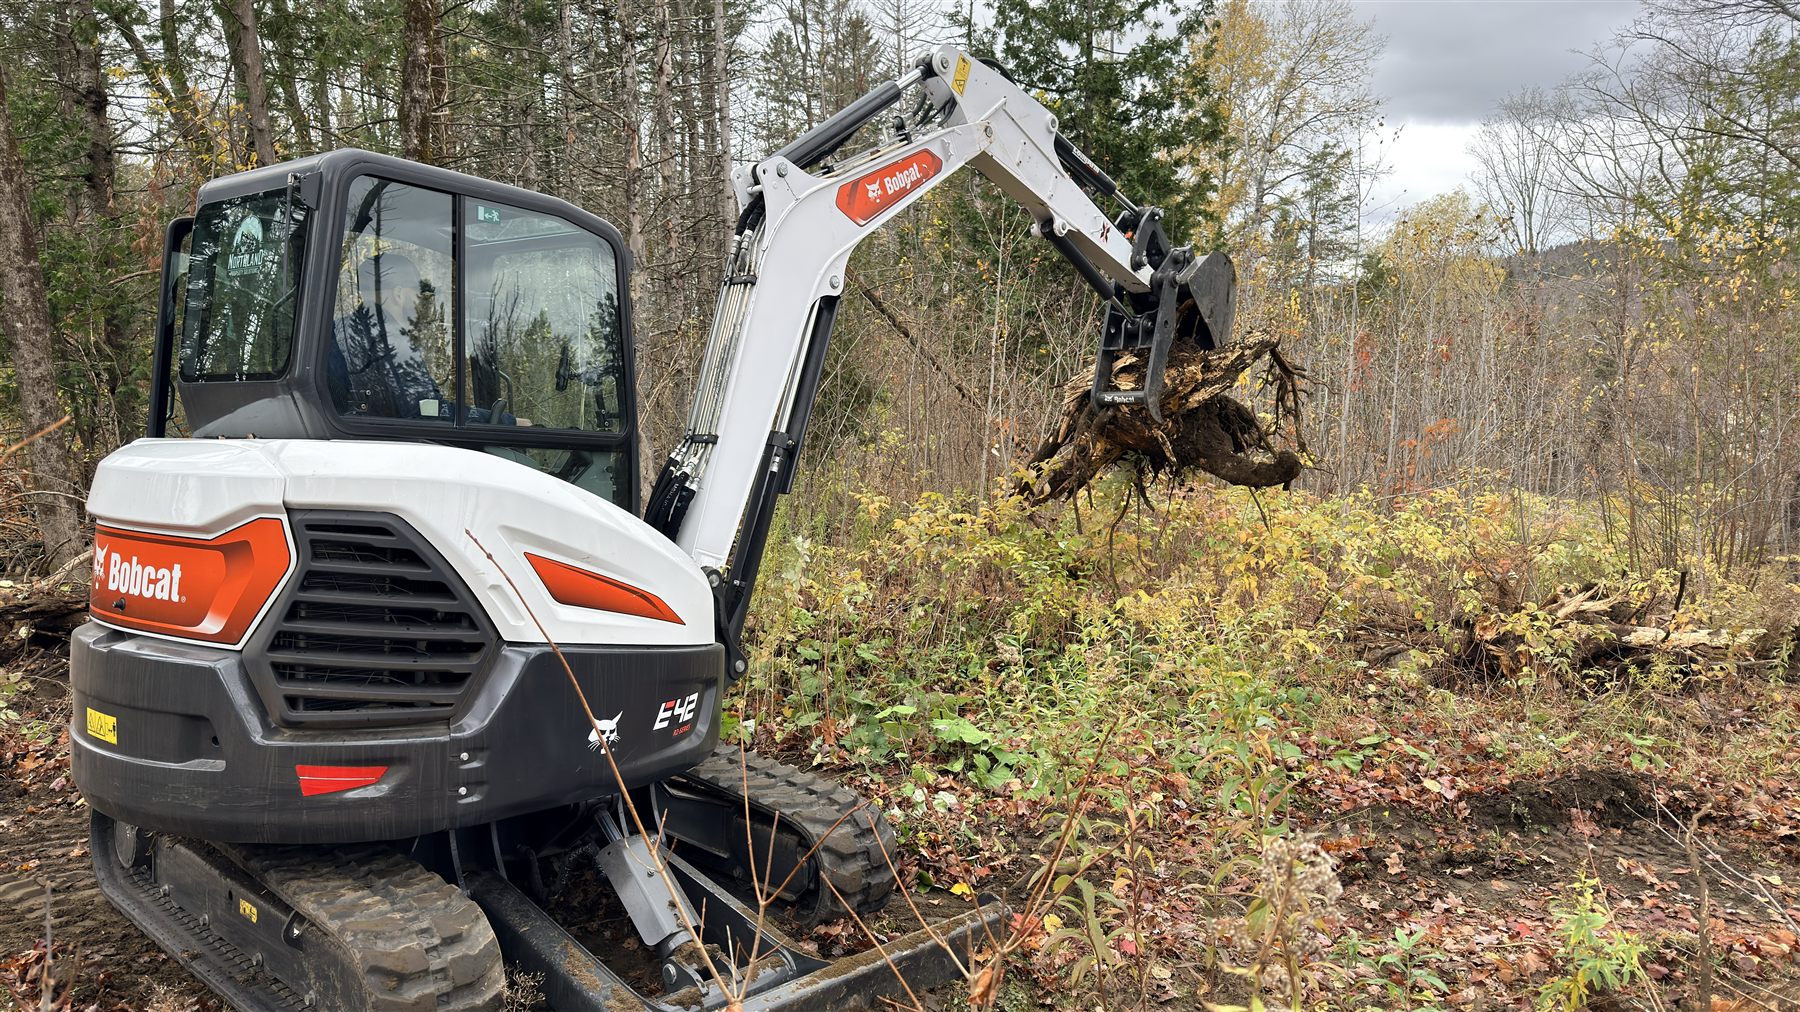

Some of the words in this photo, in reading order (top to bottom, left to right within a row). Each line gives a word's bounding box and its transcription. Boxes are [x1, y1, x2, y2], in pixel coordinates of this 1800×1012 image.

[884, 162, 920, 195] Bobcat
[108, 552, 182, 602] Bobcat
[653, 692, 698, 730] E42
